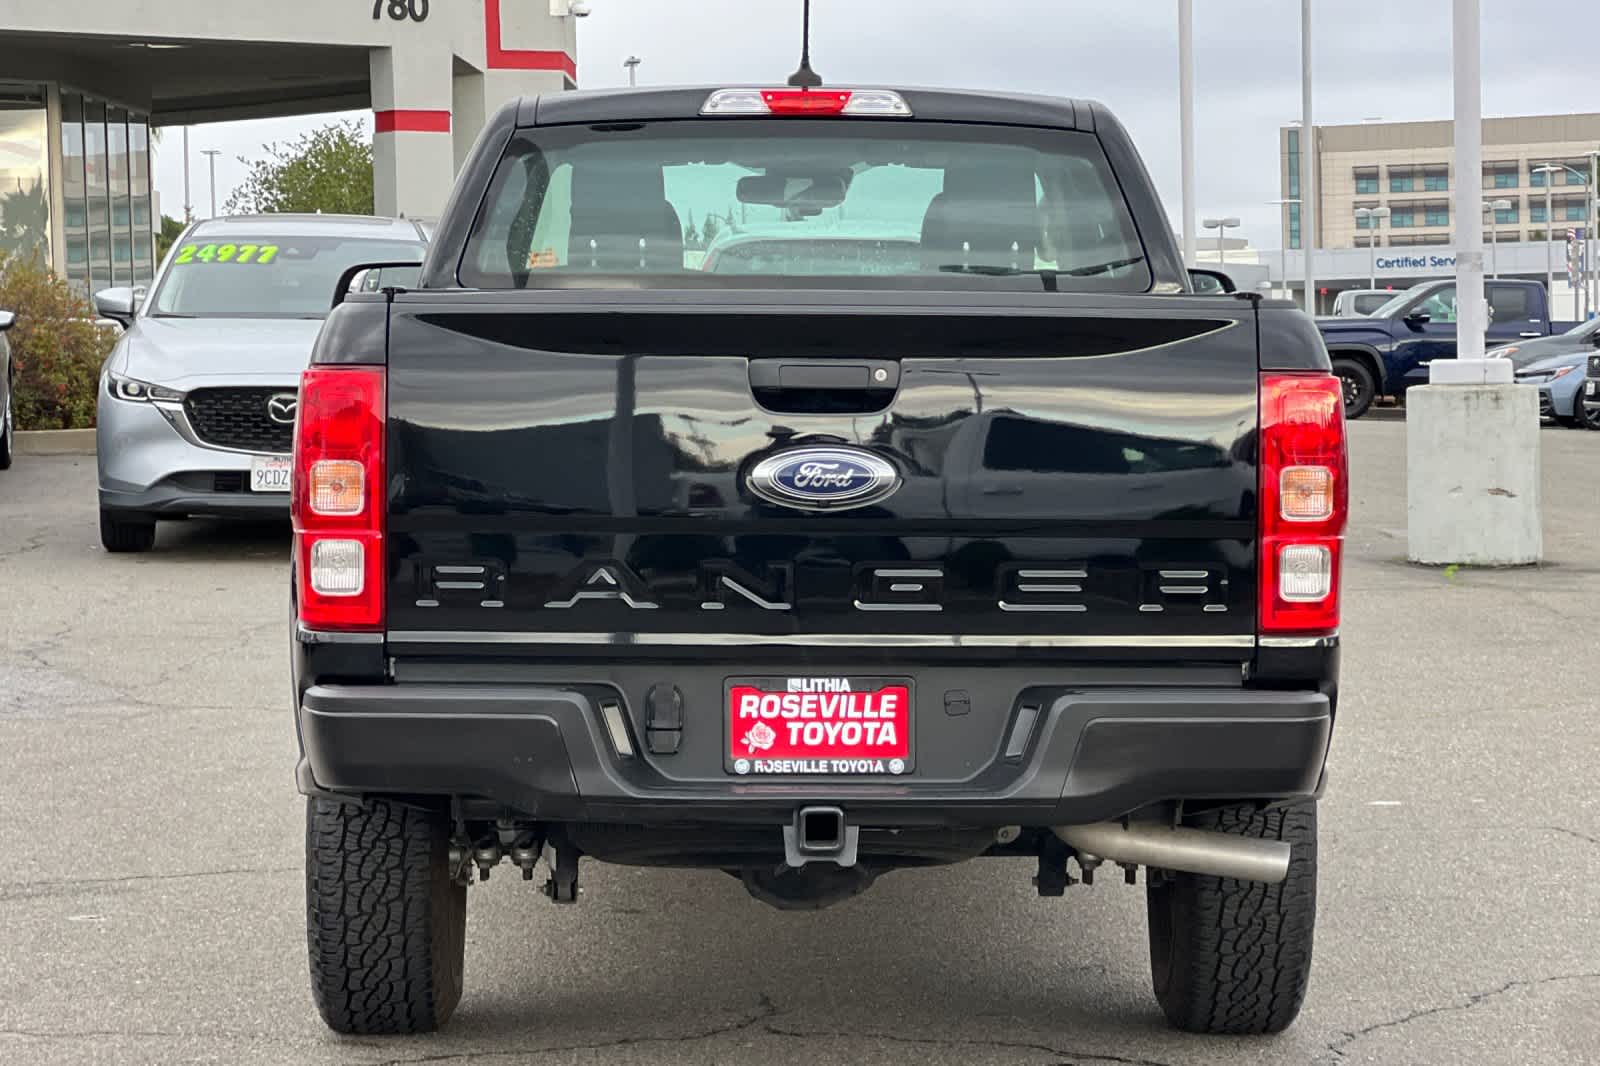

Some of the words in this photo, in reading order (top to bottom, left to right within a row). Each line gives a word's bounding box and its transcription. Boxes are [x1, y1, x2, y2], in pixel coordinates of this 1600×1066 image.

[372, 0, 429, 22] 780
[174, 243, 279, 263] 24977
[1376, 256, 1426, 268] Certified
[794, 462, 853, 488] Ford
[411, 561, 1229, 613] RANGER
[802, 678, 850, 692] LITHIA
[739, 694, 898, 718] ROSEVILLE
[786, 721, 897, 746] TOYOTA
[754, 760, 829, 773] ROSEVILLE
[831, 760, 885, 773] TOYOTA
